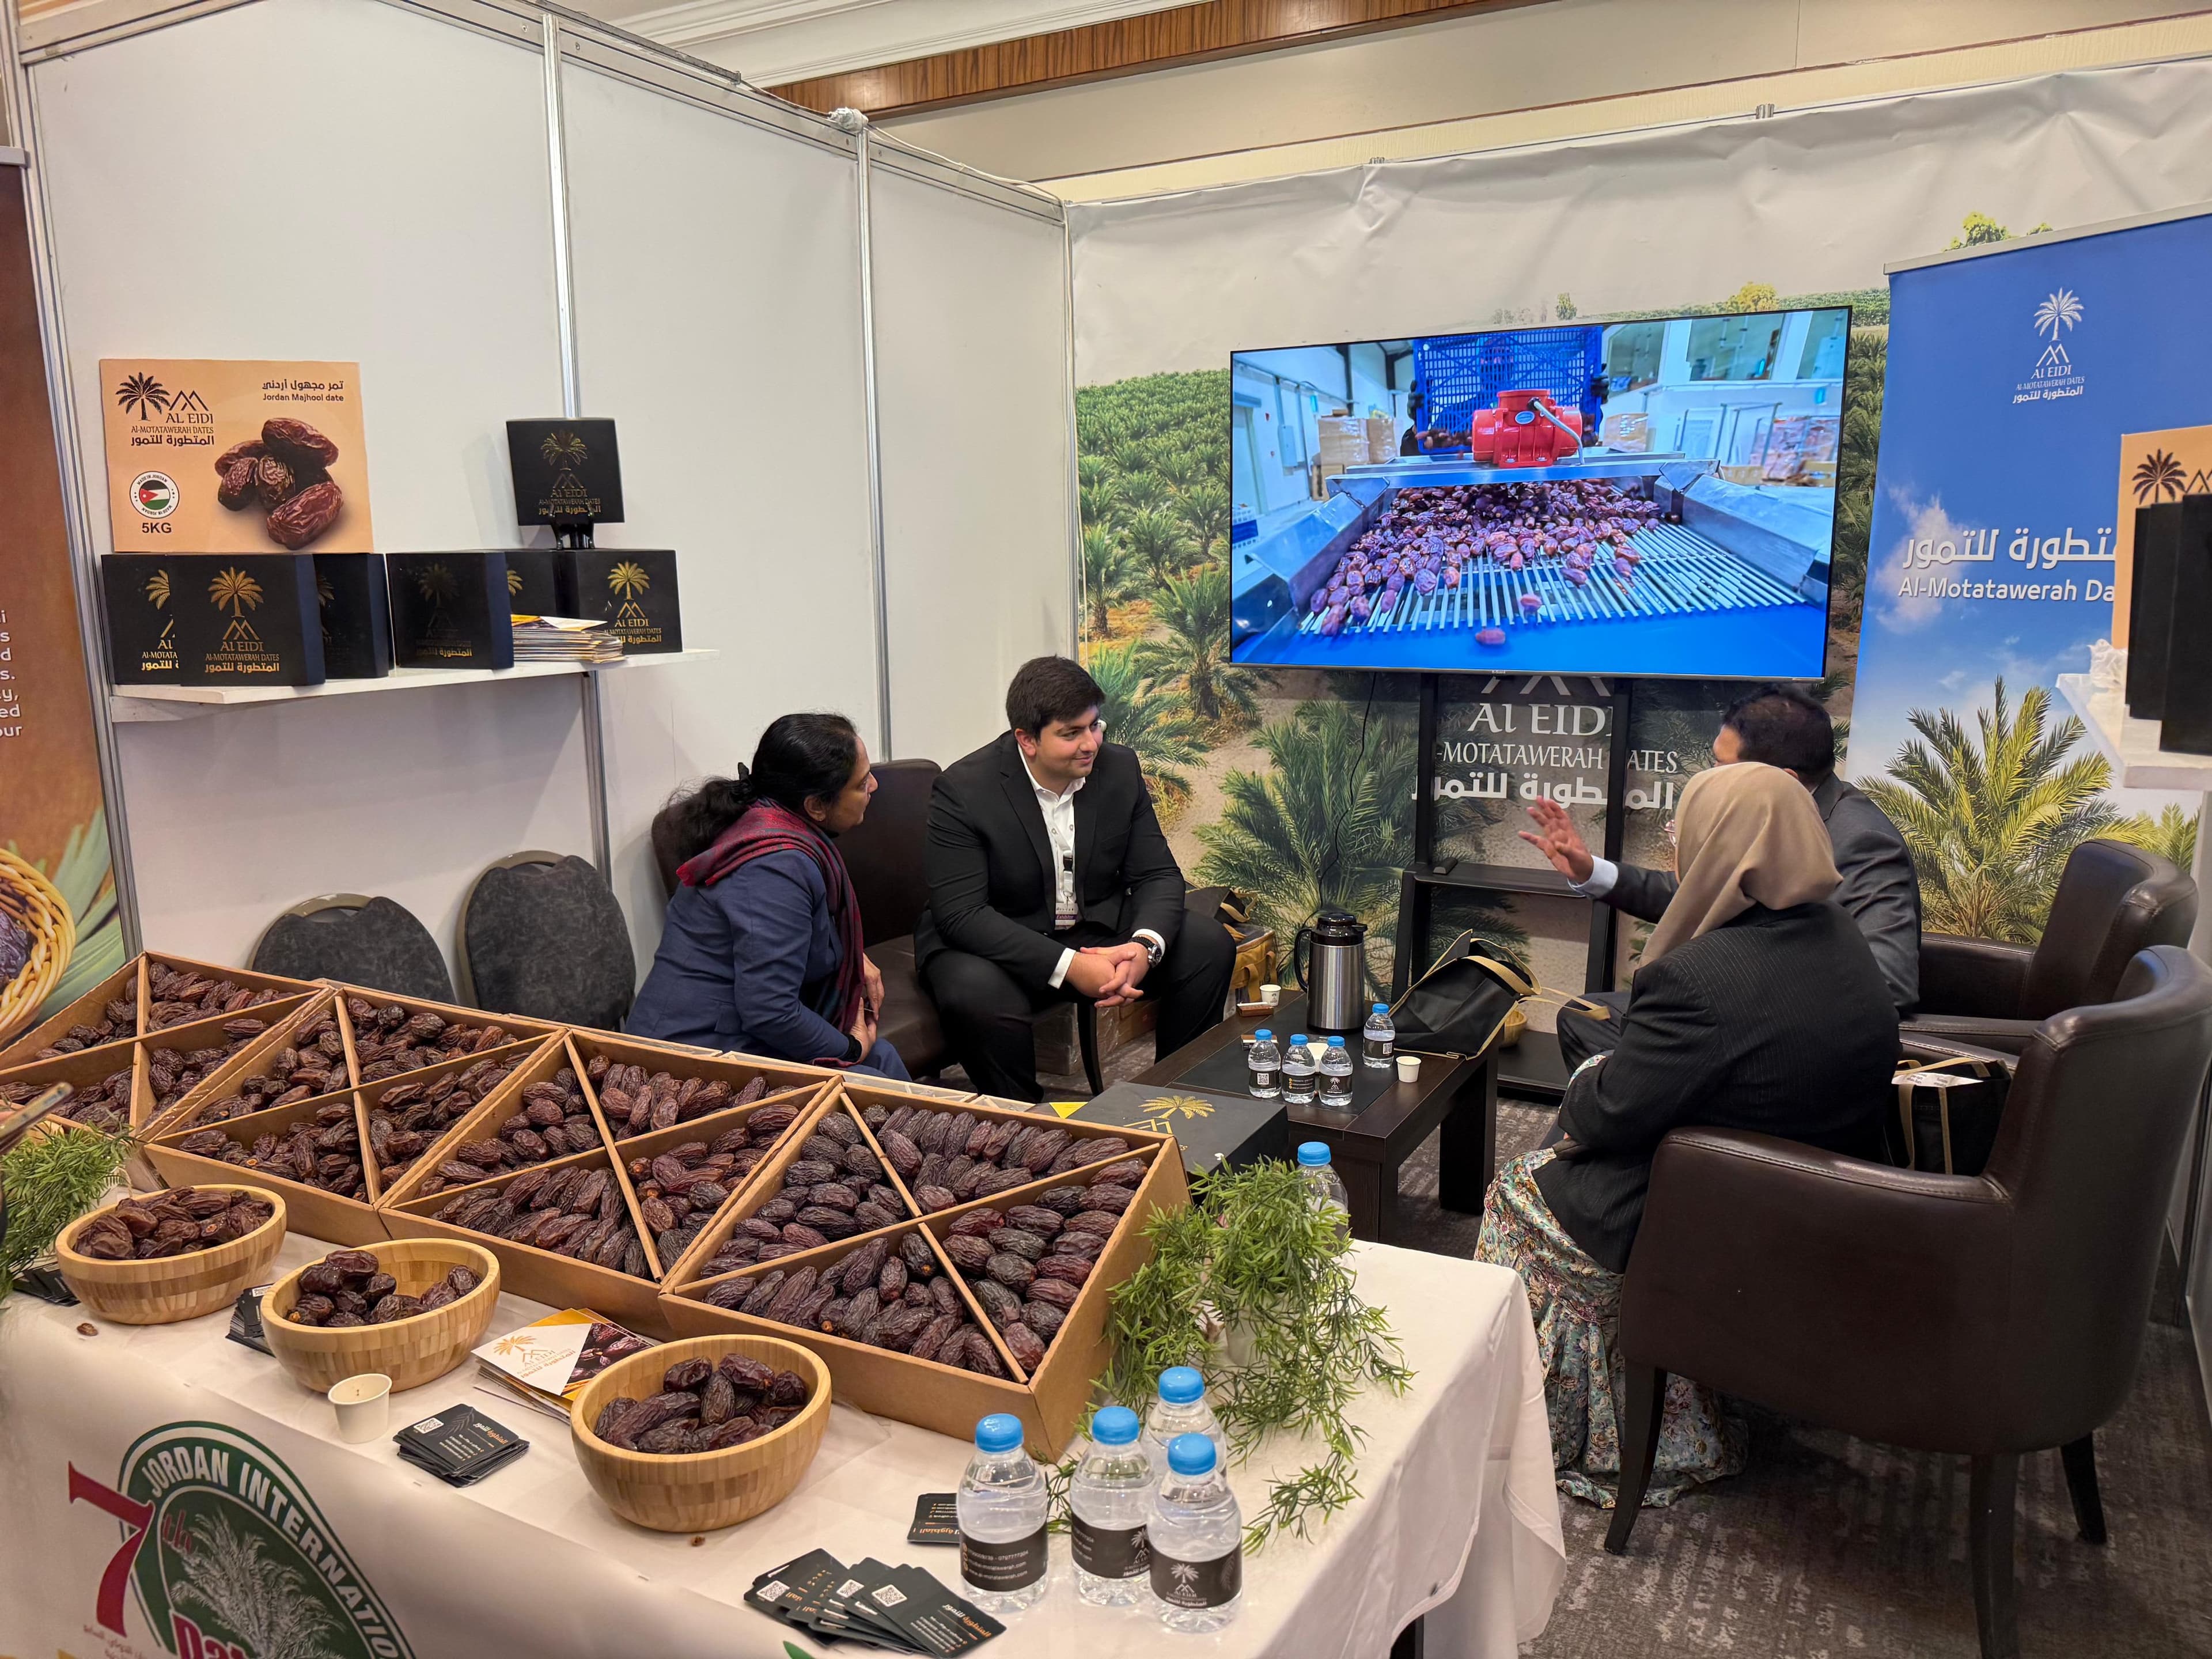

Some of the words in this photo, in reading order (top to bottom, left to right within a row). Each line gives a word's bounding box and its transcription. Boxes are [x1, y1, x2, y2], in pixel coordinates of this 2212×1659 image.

[2047, 365, 2072, 377] EIDI
[290, 380, 325, 391] مجهول
[328, 380, 344, 391] تمر
[2067, 376, 2085, 385] DATES
[291, 393, 324, 402] Majhool
[2012, 391, 2040, 404] للتمور
[2043, 385, 2084, 400] المتطورة
[166, 413, 184, 423] AL
[188, 413, 214, 424] EIDI
[193, 426, 214, 434] DATES
[131, 435, 162, 446] للتمور
[166, 435, 214, 446] المتطورة
[565, 488, 588, 498] EIDI
[565, 505, 601, 515] الطورة
[142, 522, 172, 534] 5KG
[1903, 529, 2000, 569] للتمور
[2009, 527, 2117, 570] تطورة
[1898, 577, 2078, 601] Al-Motatawerah
[628, 618, 650, 627] EIDI
[628, 635, 662, 645] المتطورة
[237, 641, 264, 652] EIDI
[440, 647, 472, 658] المتطورة
[141, 660, 172, 671] للتمور
[205, 662, 234, 673] للتمور
[237, 662, 280, 673] المتطورة
[1467, 702, 1517, 734] Al
[1437, 741, 1604, 770] -MOTATAWERAH
[1627, 749, 1678, 774] ATES
[1520, 772, 1674, 810] المطورة
[142, 1446, 229, 1498] JORDAN
[942, 1604, 966, 1618] للتمور
